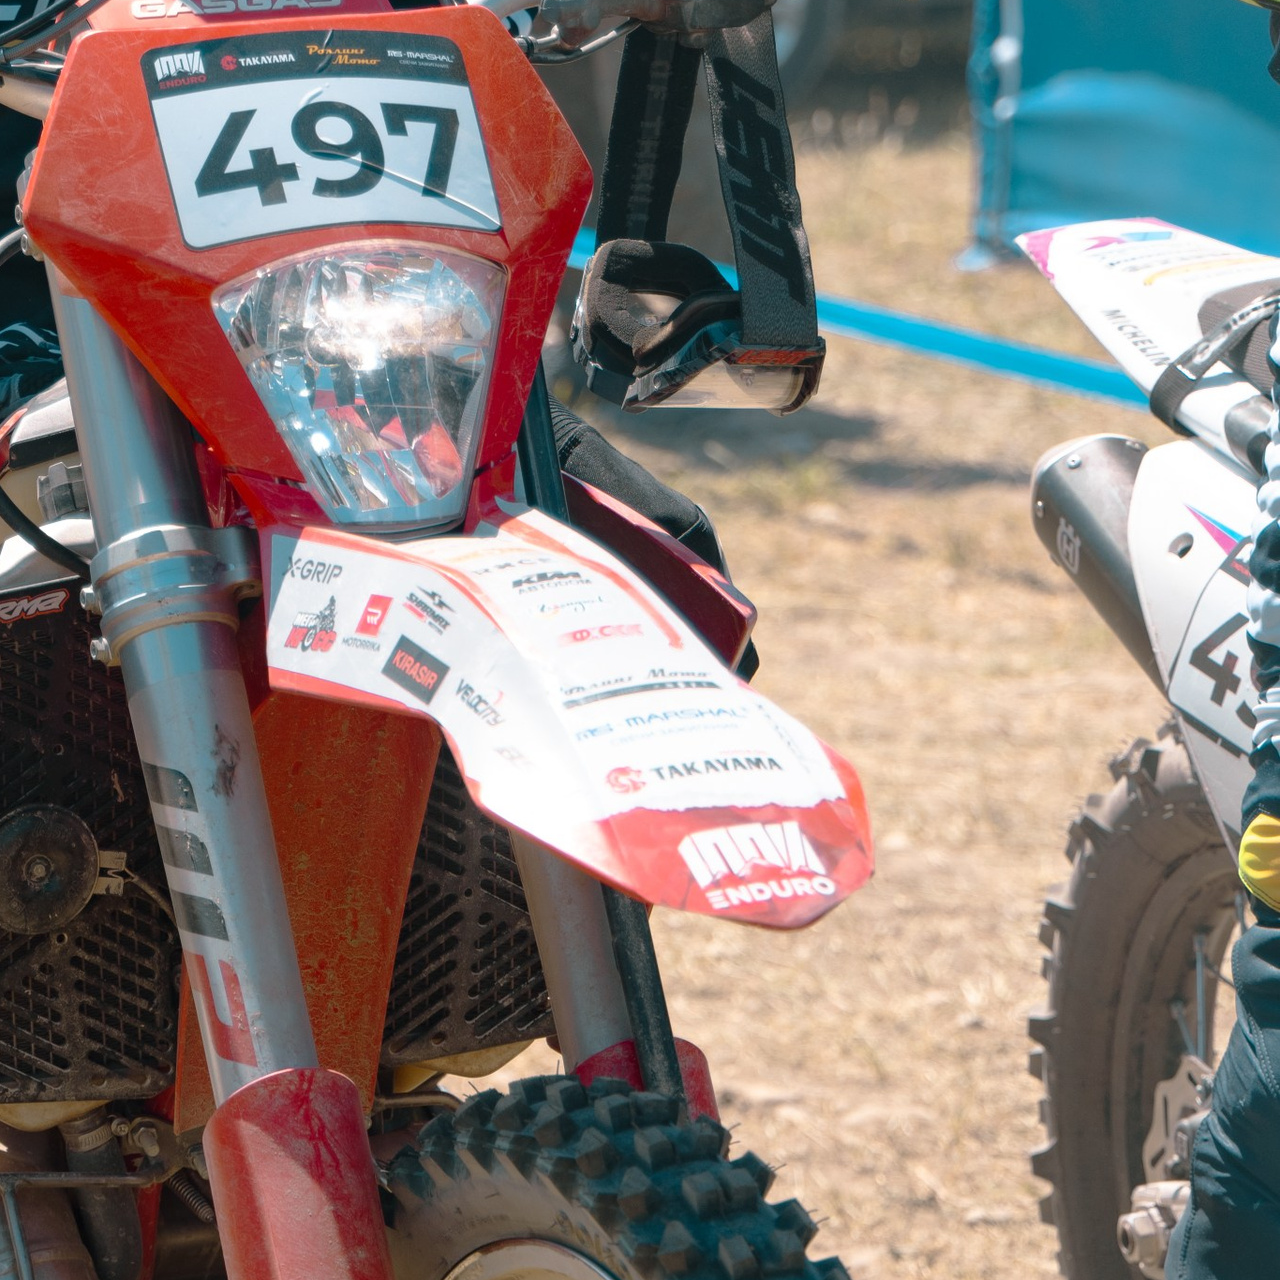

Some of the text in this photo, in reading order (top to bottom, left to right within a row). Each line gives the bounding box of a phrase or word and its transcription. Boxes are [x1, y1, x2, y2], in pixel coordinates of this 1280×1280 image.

[238, 53, 296, 67] TAKAYAMA
[158, 74, 207, 90] ENDURO
[194, 100, 460, 207] 497
[1102, 309, 1173, 368] MICHELIN
[282, 556, 343, 585] X-GRIP
[511, 571, 582, 589] KTM
[392, 648, 439, 692] KIRASIR
[454, 678, 505, 727] VELOCITY
[650, 756, 783, 782] TAKAYAMA
[704, 876, 836, 910] ENDURO
